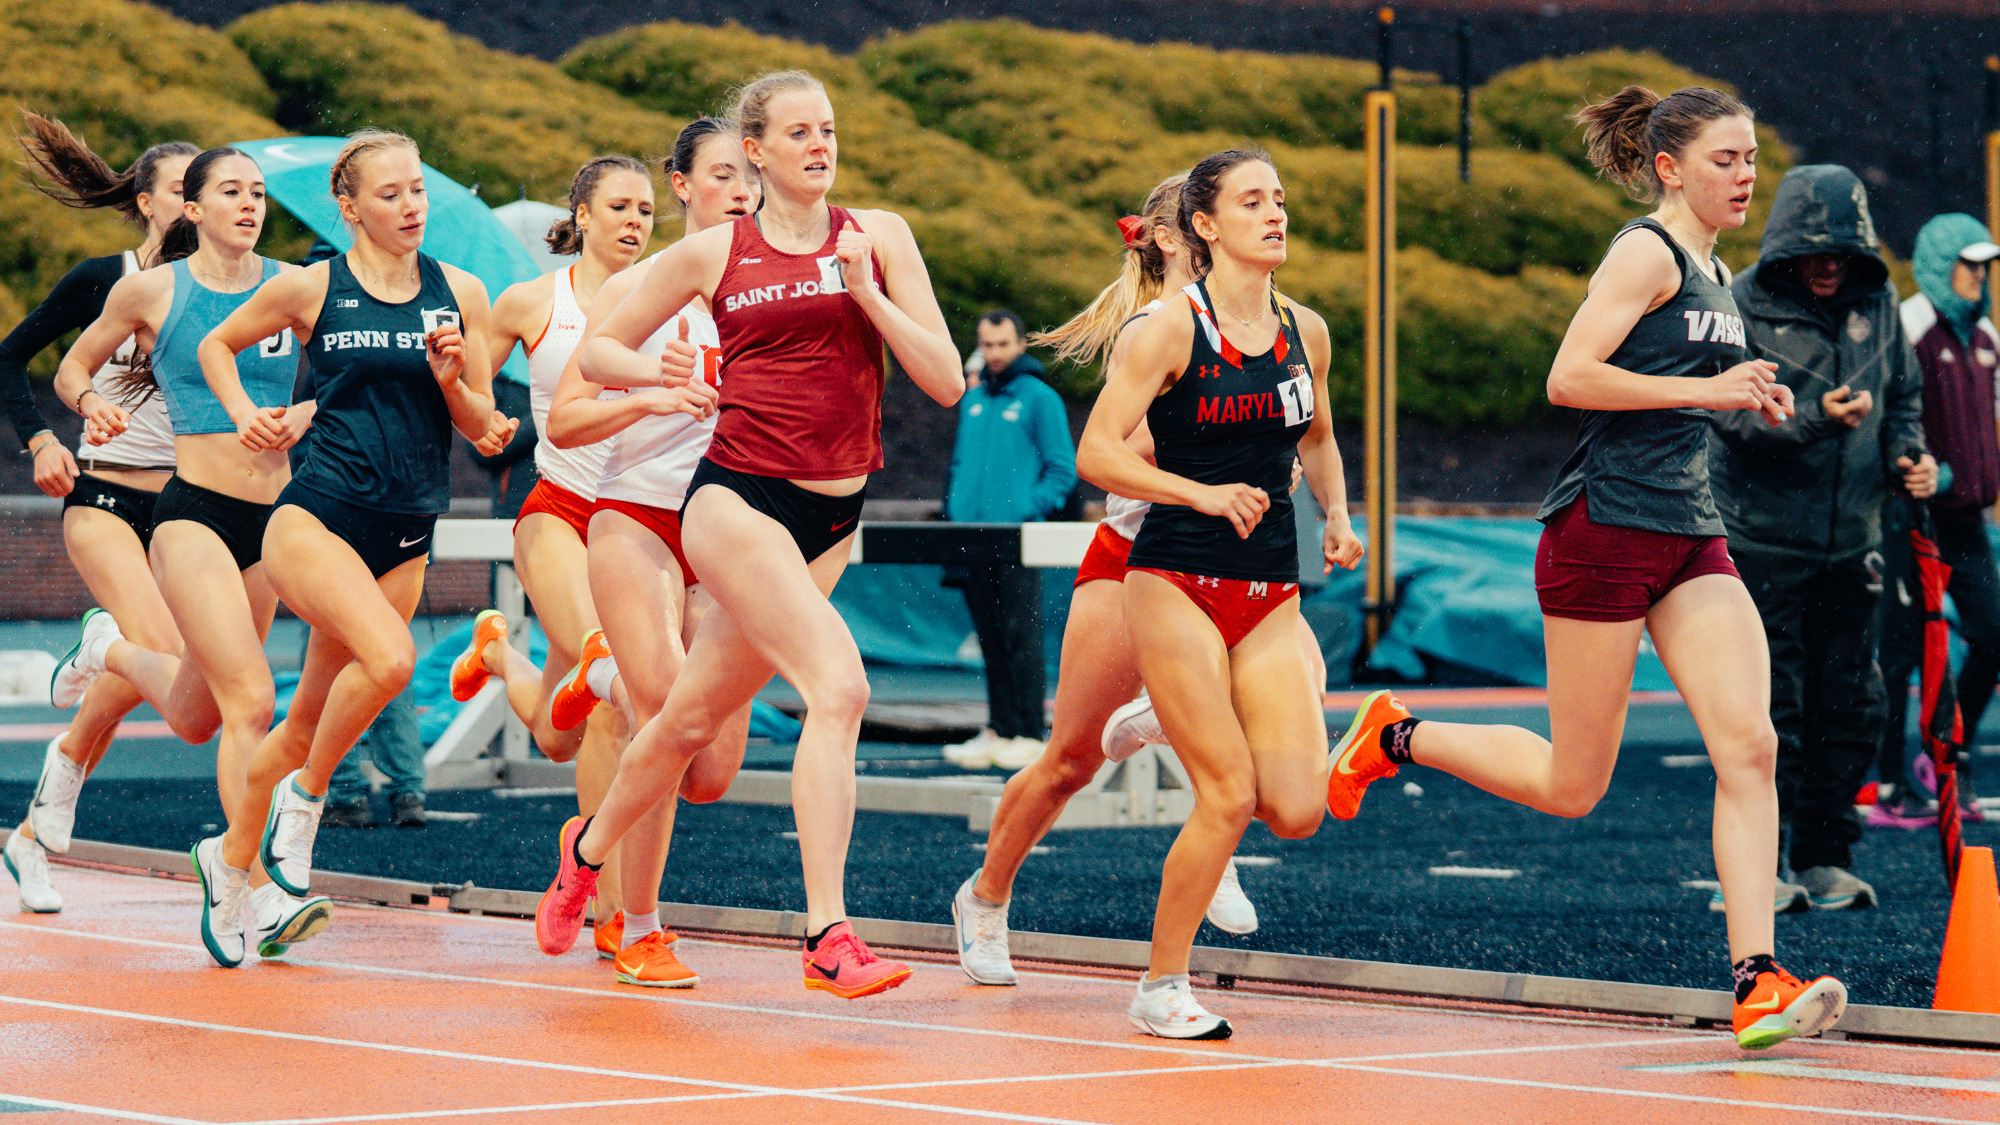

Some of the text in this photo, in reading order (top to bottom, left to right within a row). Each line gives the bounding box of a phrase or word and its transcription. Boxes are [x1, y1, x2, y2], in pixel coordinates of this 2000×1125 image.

[725, 284, 787, 313] SAINT
[322, 330, 427, 352] PENN ST
[1288, 381, 1313, 421] 1
[1246, 580, 1269, 597] M
